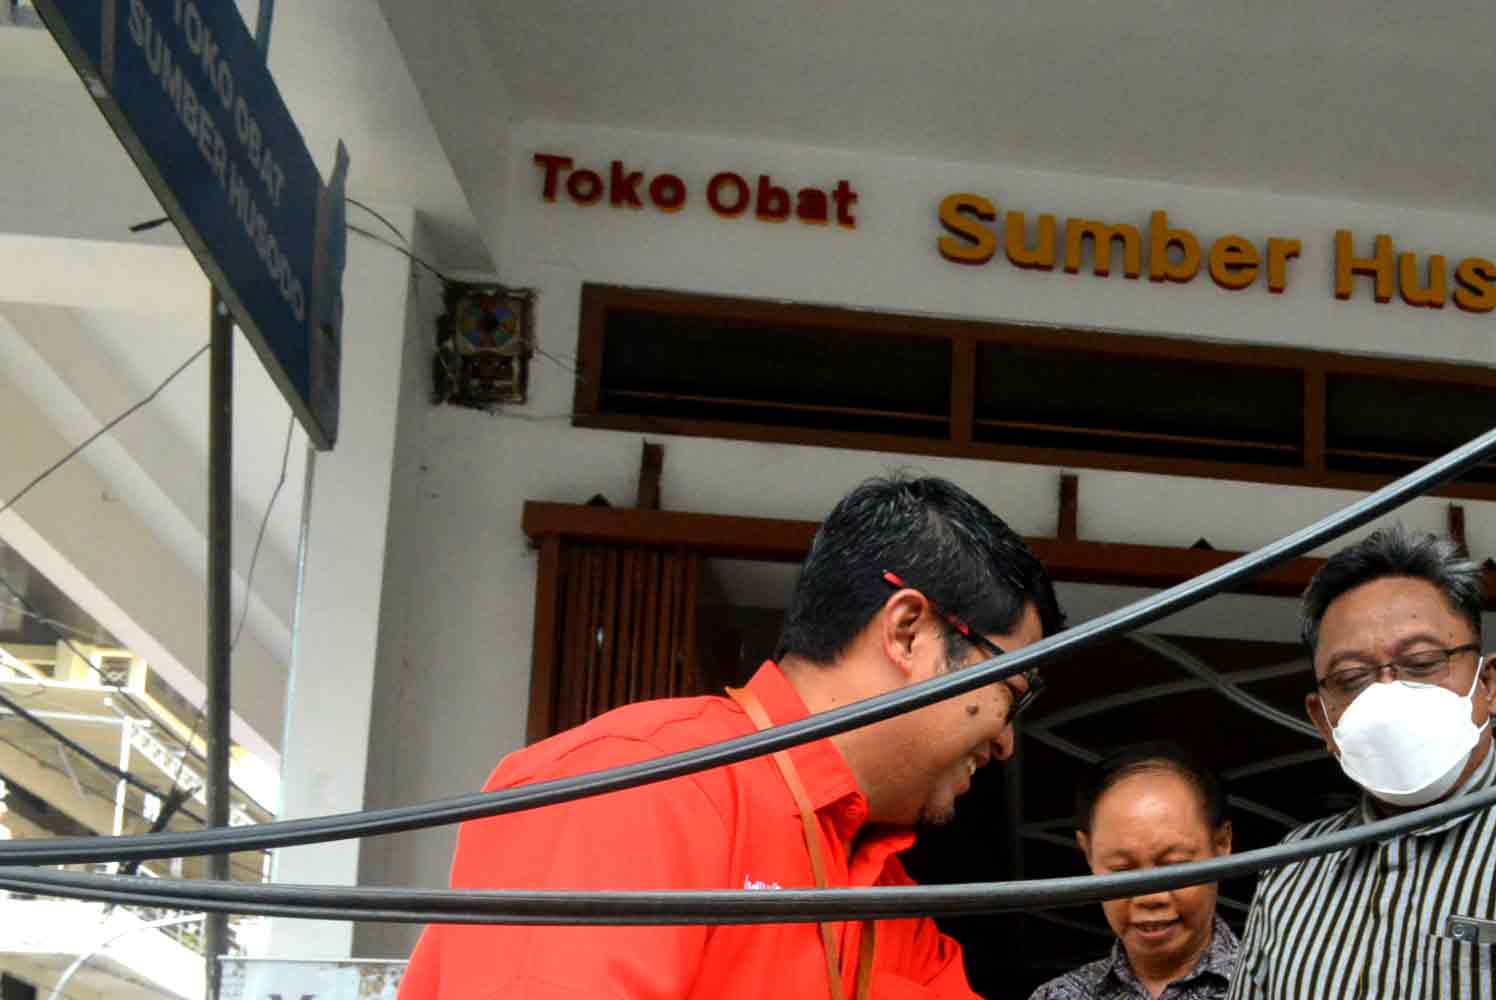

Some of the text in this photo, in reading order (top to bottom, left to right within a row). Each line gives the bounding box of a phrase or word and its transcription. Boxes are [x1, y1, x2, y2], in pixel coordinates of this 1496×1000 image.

[172, 0, 234, 112] OKO
[534, 153, 858, 231] Toko Obat
[937, 192, 1302, 295] Sumber
